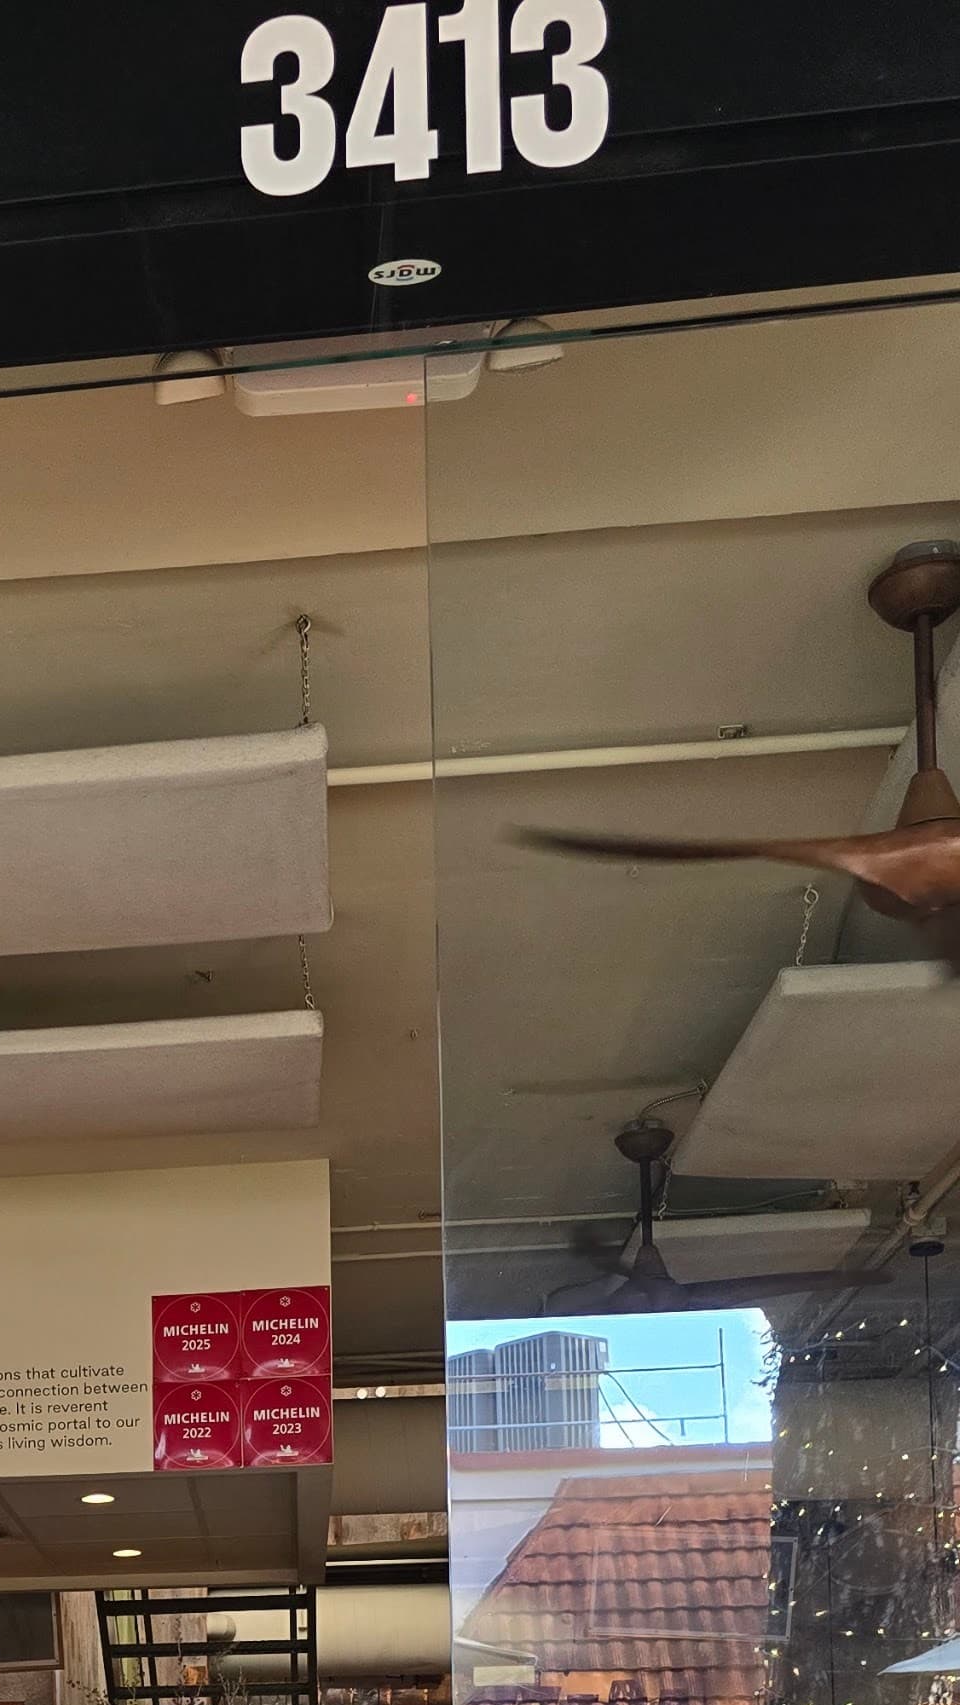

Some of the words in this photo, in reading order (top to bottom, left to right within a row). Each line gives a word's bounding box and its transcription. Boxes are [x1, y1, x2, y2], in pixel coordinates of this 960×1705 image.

[241, 0, 609, 196] 3413
[163, 1323, 229, 1337] MICHELIN
[252, 1318, 319, 1332] MICHELIN
[182, 1339, 211, 1351] 2025
[271, 1334, 301, 1346] 2024
[26, 1367, 55, 1380] that
[60, 1365, 125, 1378] cultivate
[83, 1382, 148, 1395] between
[16, 1402, 26, 1414] It
[30, 1402, 42, 1414] is
[47, 1400, 108, 1413] reverent
[253, 1407, 320, 1421] MICHELIN
[47, 1417, 91, 1433] portal
[96, 1418, 111, 1429] to
[116, 1417, 141, 1429] our
[164, 1411, 230, 1425] MICHELIN
[182, 1427, 212, 1439] 2022
[272, 1423, 302, 1435] 2023
[8, 1437, 46, 1451] living
[50, 1434, 112, 1448] wisdom.
